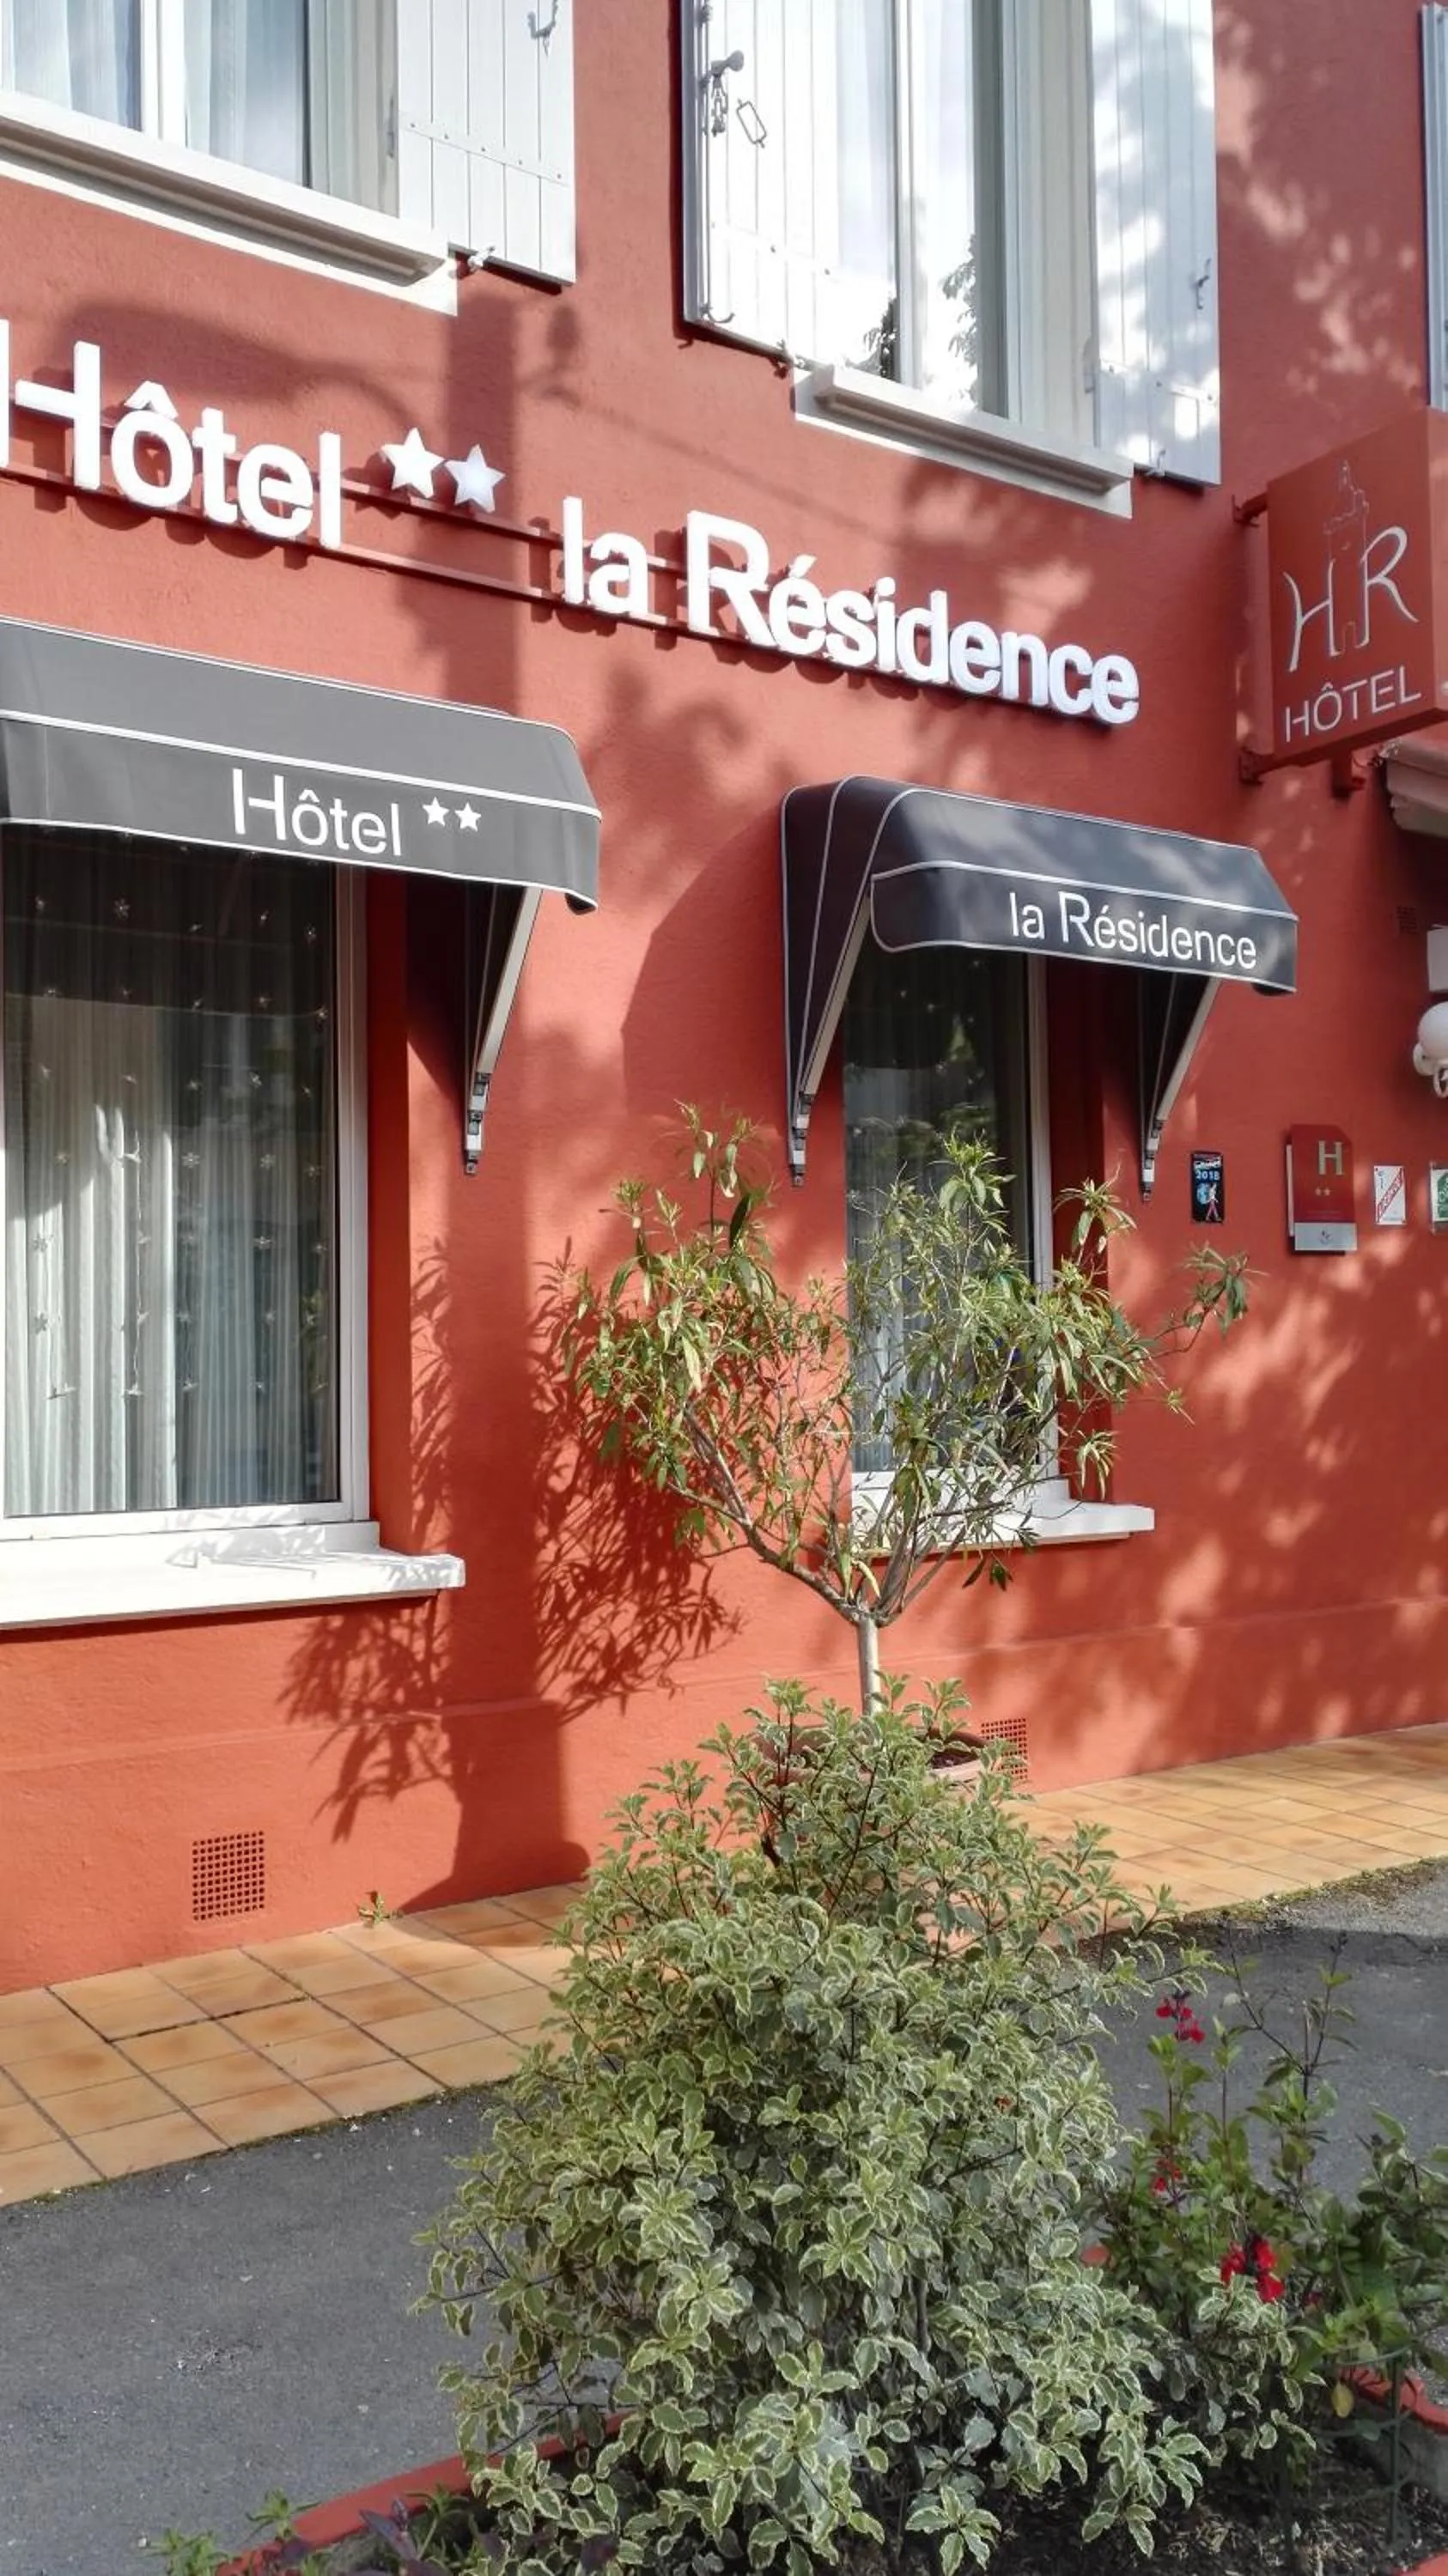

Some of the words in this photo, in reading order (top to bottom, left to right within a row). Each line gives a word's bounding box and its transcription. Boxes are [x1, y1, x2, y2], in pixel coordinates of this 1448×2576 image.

[0, 319, 341, 549] Hôtel
[563, 495, 648, 617] la
[687, 509, 1140, 725] Résidence
[1285, 665, 1421, 743] HÔTEL
[232, 769, 402, 857] Hôtel
[1009, 891, 1045, 940] la
[1058, 890, 1256, 969] Résidence
[1318, 1140, 1343, 1176] H
